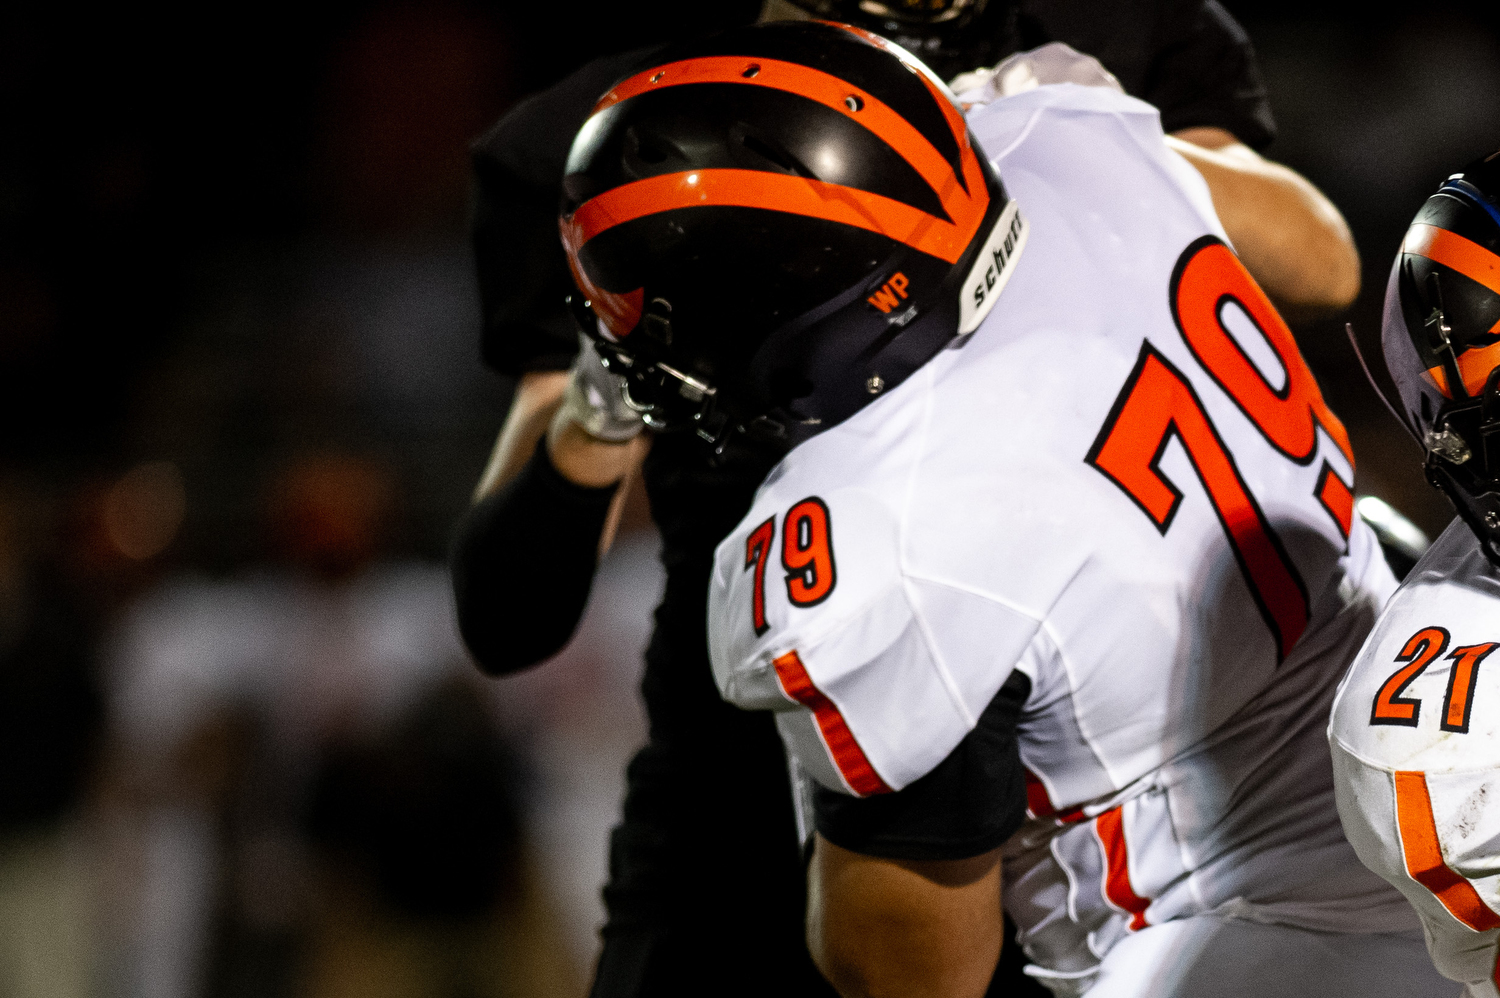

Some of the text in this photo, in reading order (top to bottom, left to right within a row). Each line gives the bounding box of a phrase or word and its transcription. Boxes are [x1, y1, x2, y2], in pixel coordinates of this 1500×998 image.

[866, 271, 910, 314] WP
[1084, 234, 1356, 666] 79
[744, 496, 837, 638] 79
